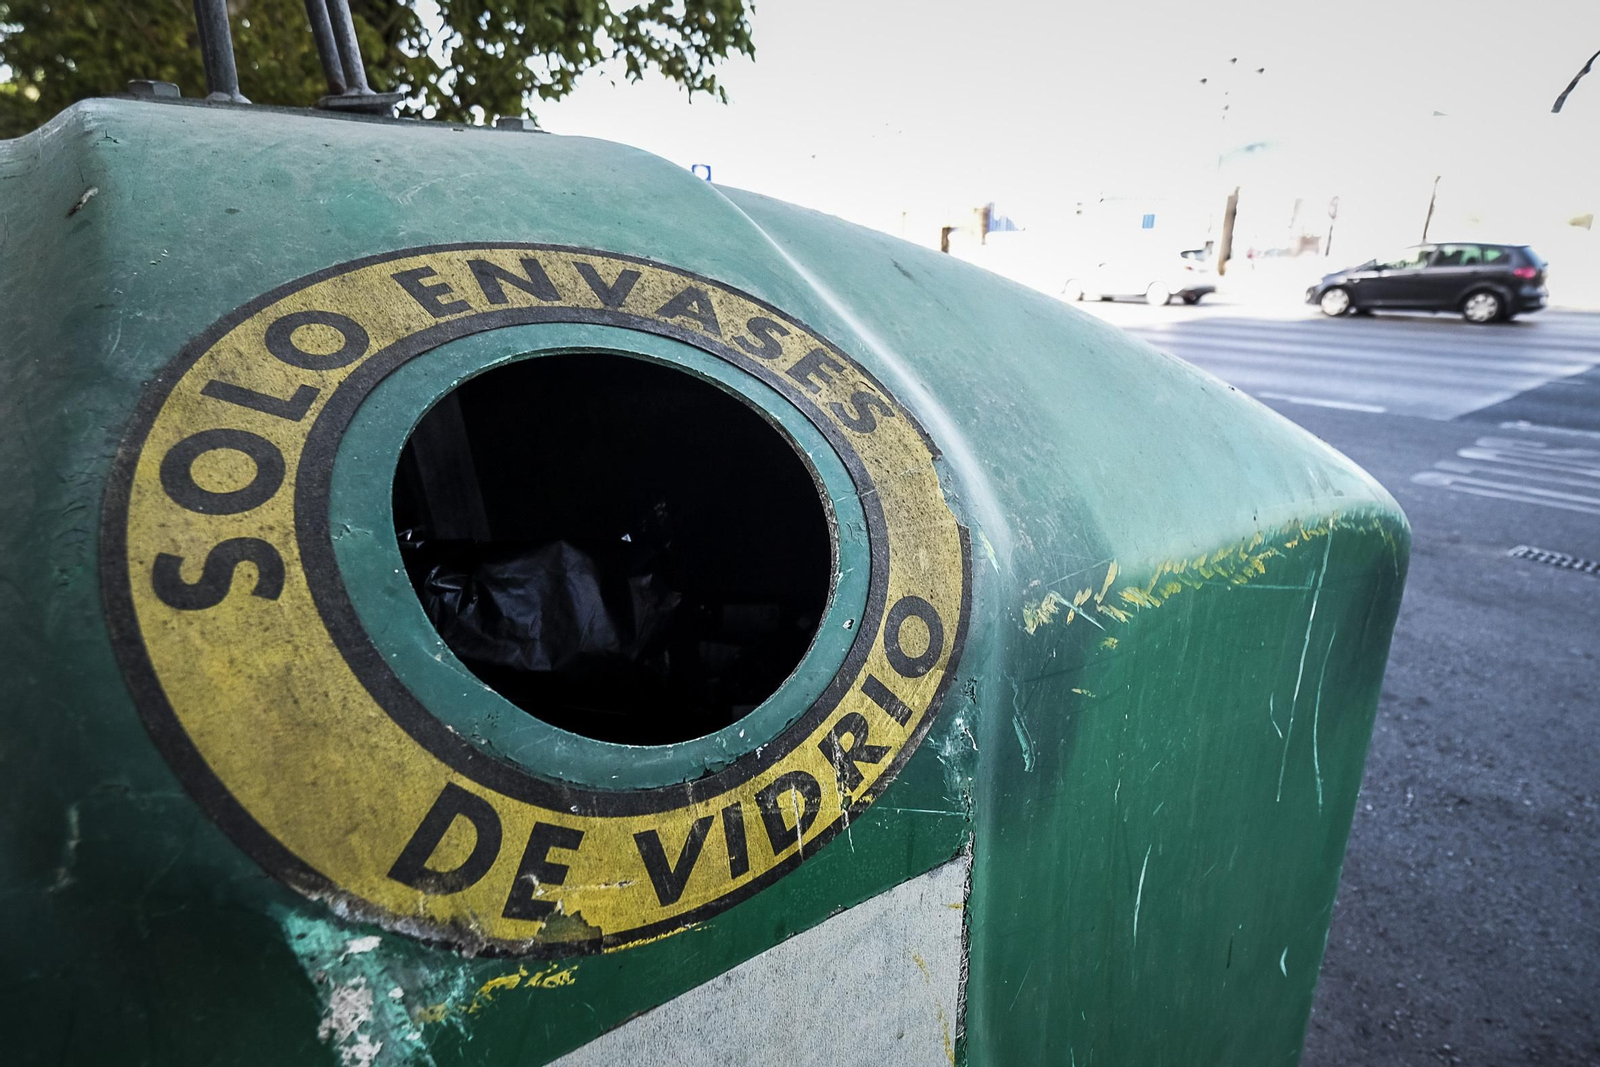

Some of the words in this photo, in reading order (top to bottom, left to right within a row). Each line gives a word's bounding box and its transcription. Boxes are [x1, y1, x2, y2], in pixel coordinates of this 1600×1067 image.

[152, 310, 370, 611] SOLO
[391, 258, 895, 433] ENVASES
[386, 781, 585, 922] DE
[633, 595, 944, 907] VIDRIO
